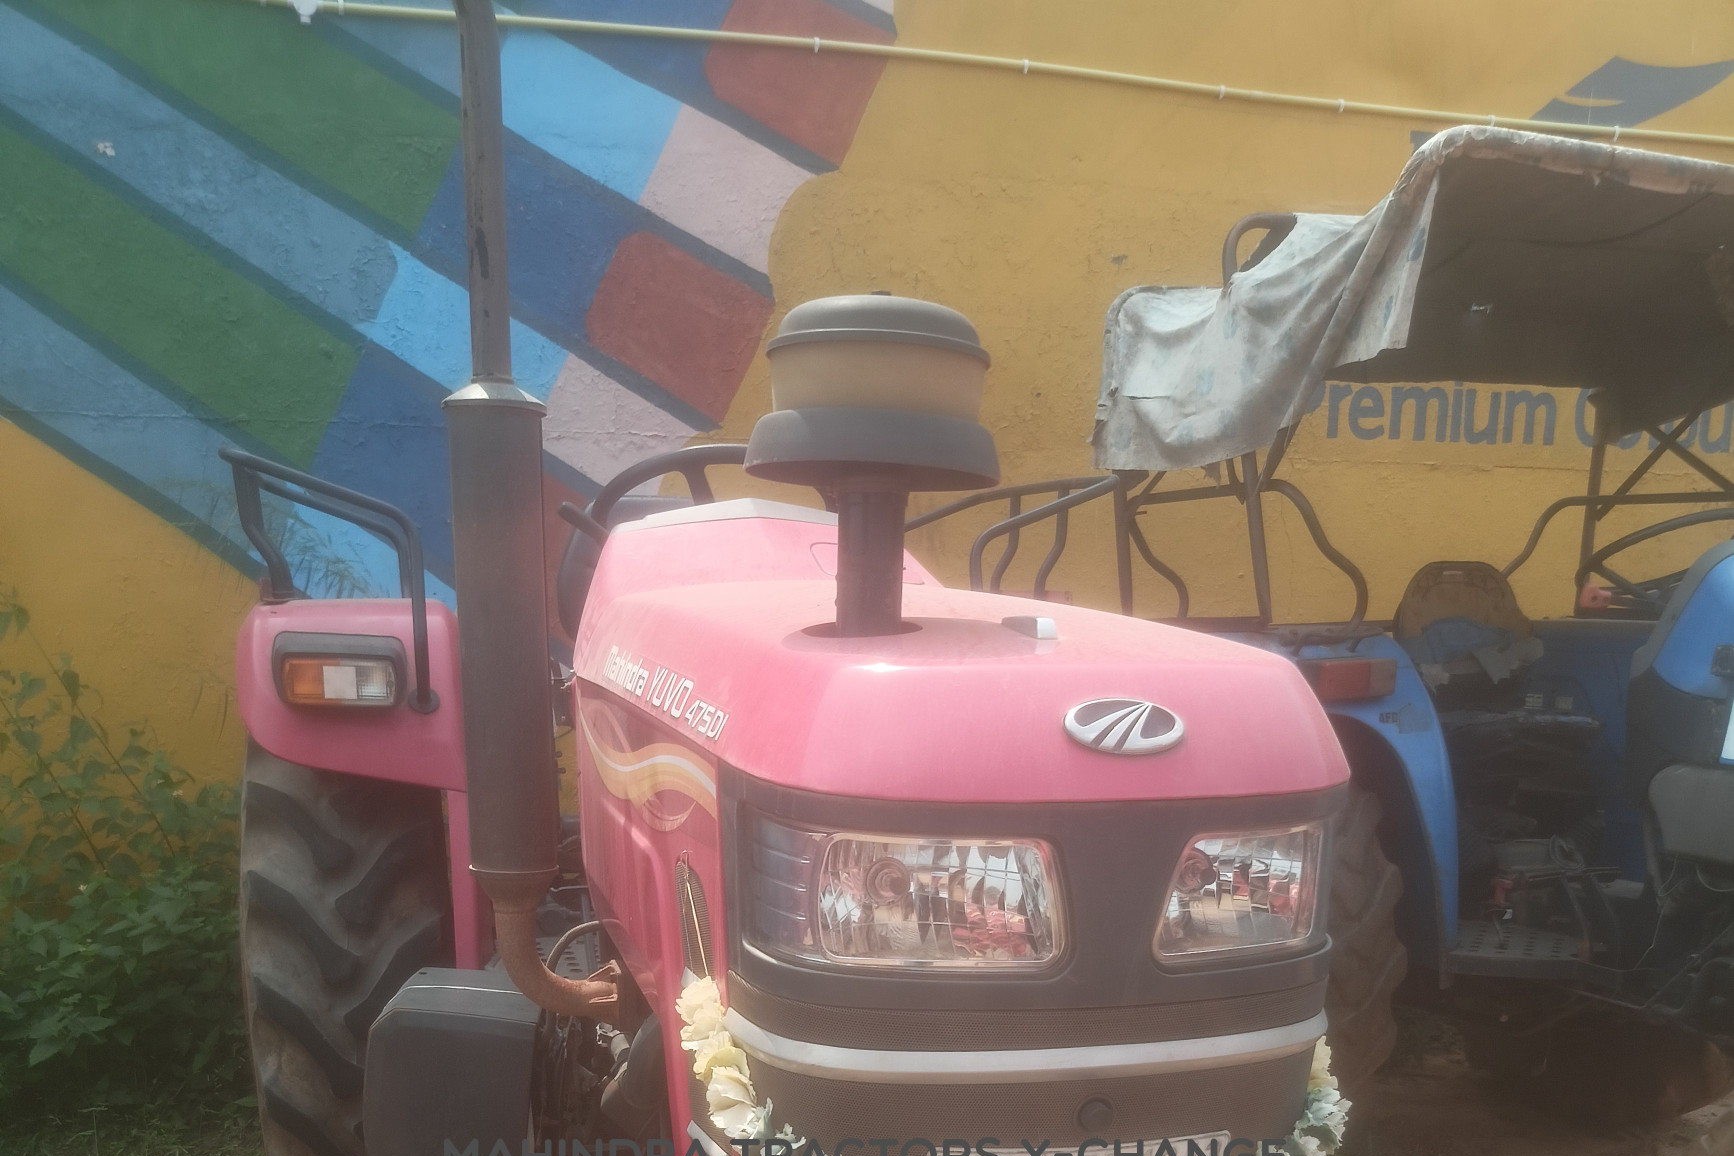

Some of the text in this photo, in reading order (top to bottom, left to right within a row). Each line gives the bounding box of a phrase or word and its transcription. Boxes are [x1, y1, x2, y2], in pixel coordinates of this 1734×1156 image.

[603, 645, 729, 741] Mahindra YUVO 475DI
